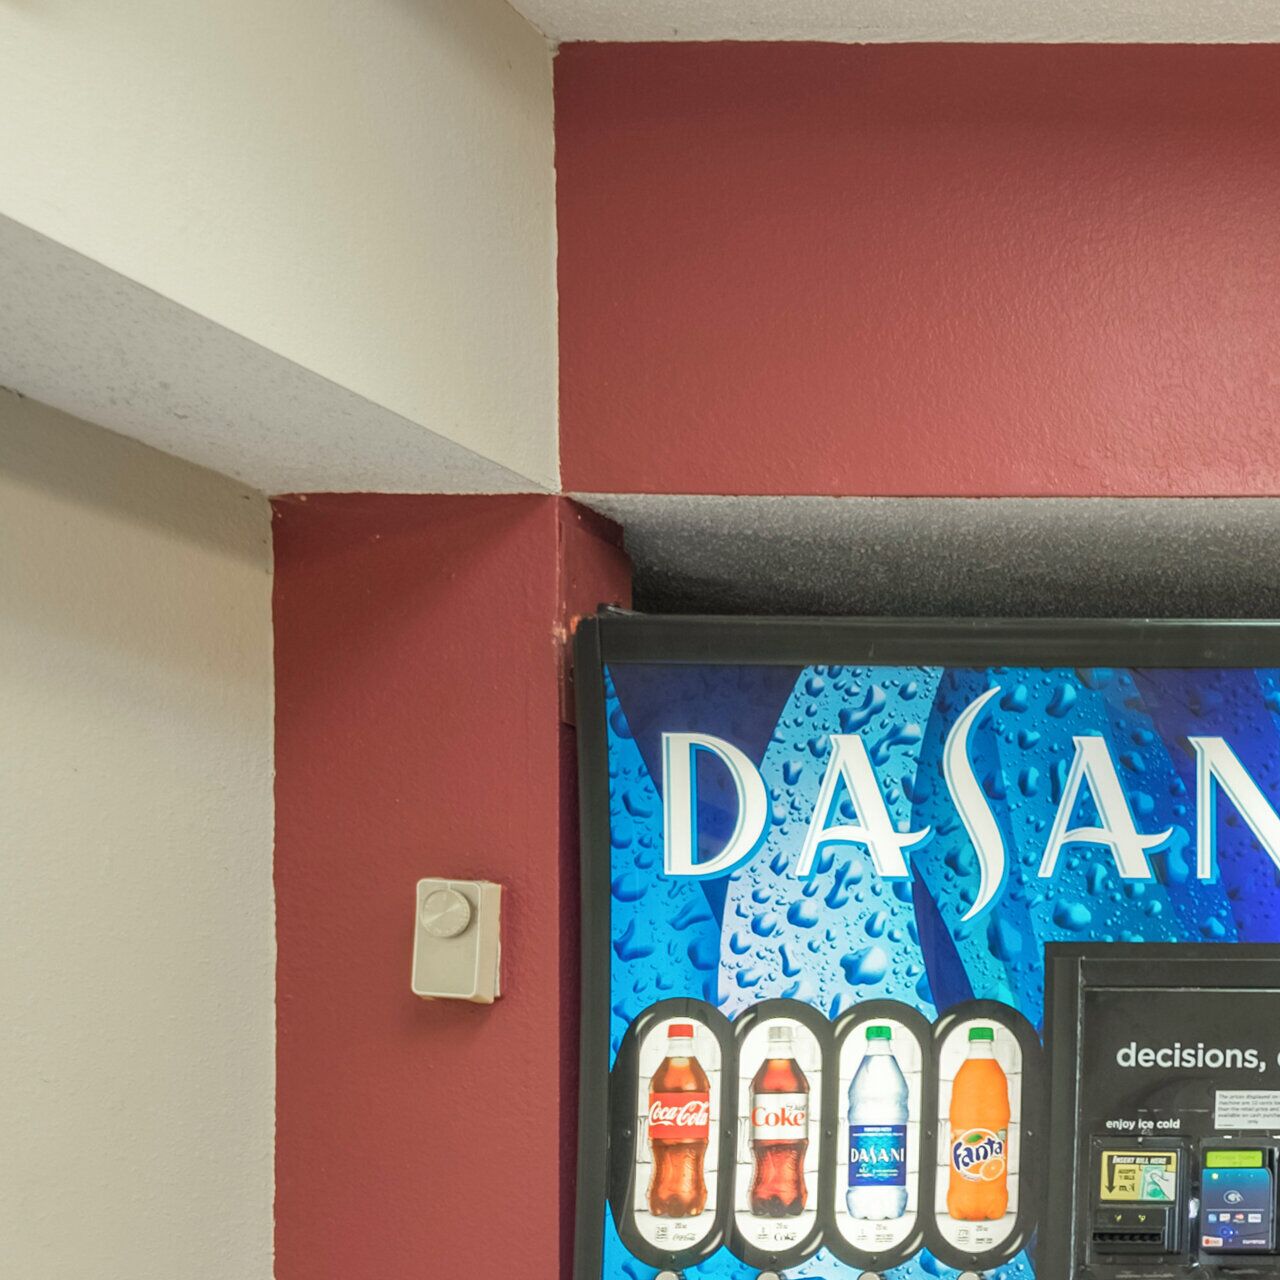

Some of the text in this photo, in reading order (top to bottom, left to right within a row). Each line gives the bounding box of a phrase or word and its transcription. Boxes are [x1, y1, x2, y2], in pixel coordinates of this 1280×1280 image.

[1116, 1042, 1267, 1072] decisions,
[649, 1100, 709, 1127] Coca-Cola
[751, 1106, 806, 1127] Coke
[1105, 1118, 1180, 1130] enjoy ice cold
[850, 1145, 905, 1164] DASANI
[953, 1137, 1003, 1170] Fanta
